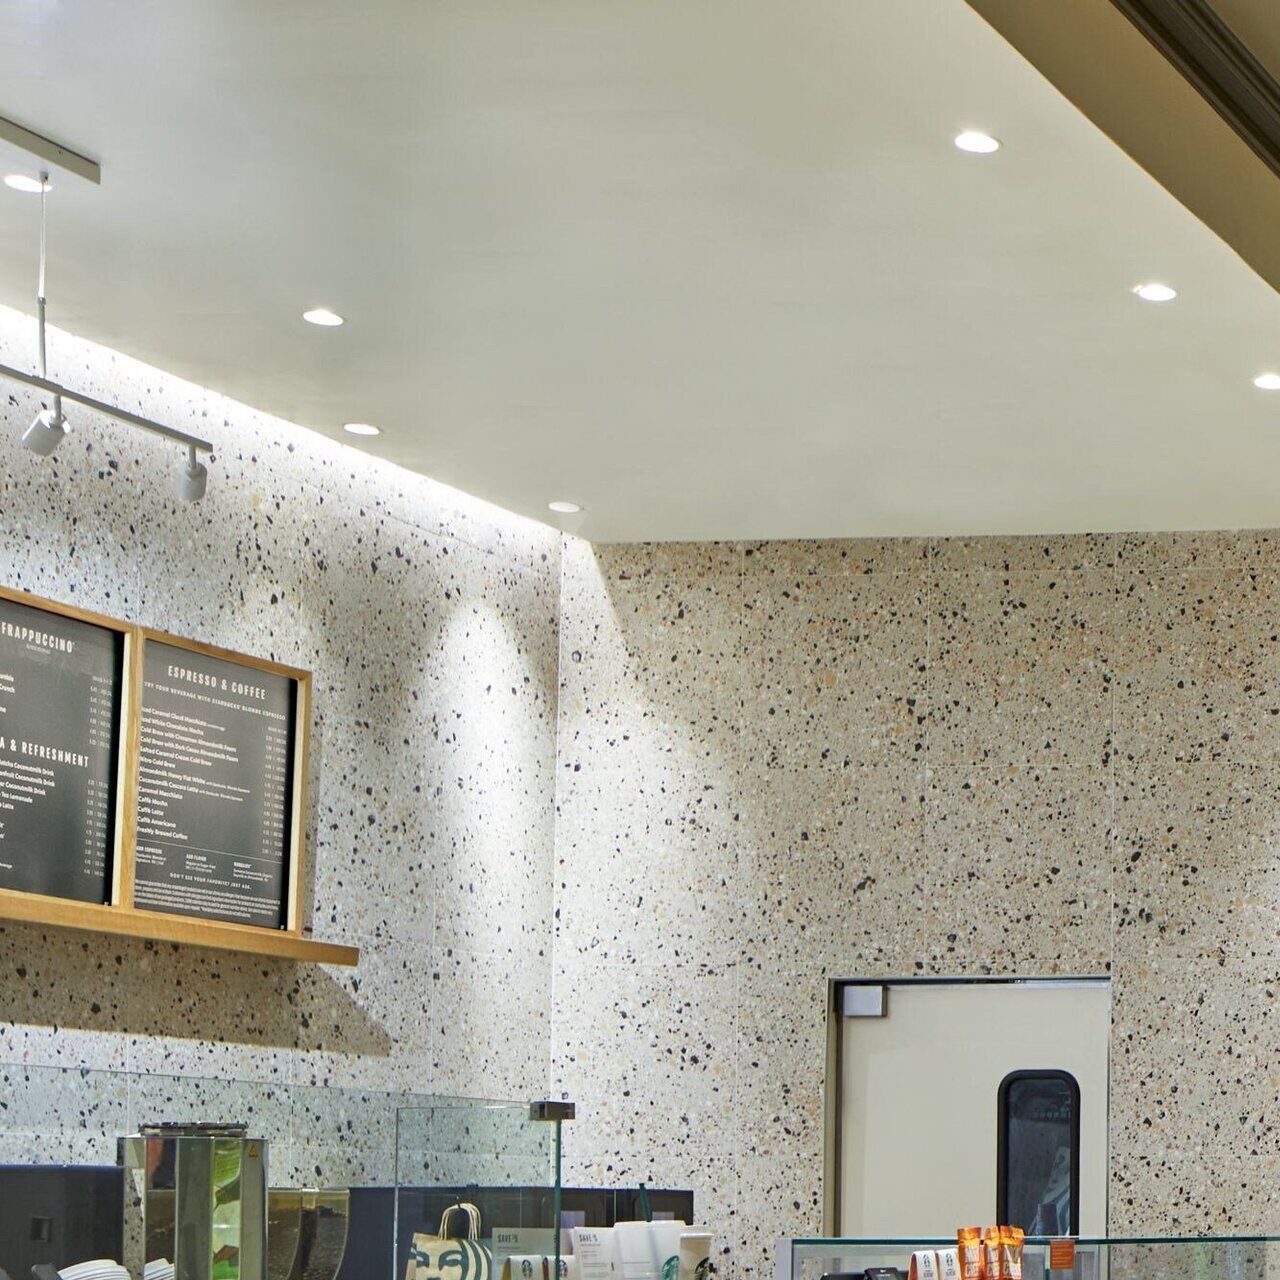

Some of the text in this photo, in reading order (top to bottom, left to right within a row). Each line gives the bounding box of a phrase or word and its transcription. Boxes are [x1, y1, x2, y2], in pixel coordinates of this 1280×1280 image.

[168, 665, 266, 700] ESPRESSO & COFFEE
[10, 738, 17, 752] &
[22, 740, 89, 768] REFRESHMENT
